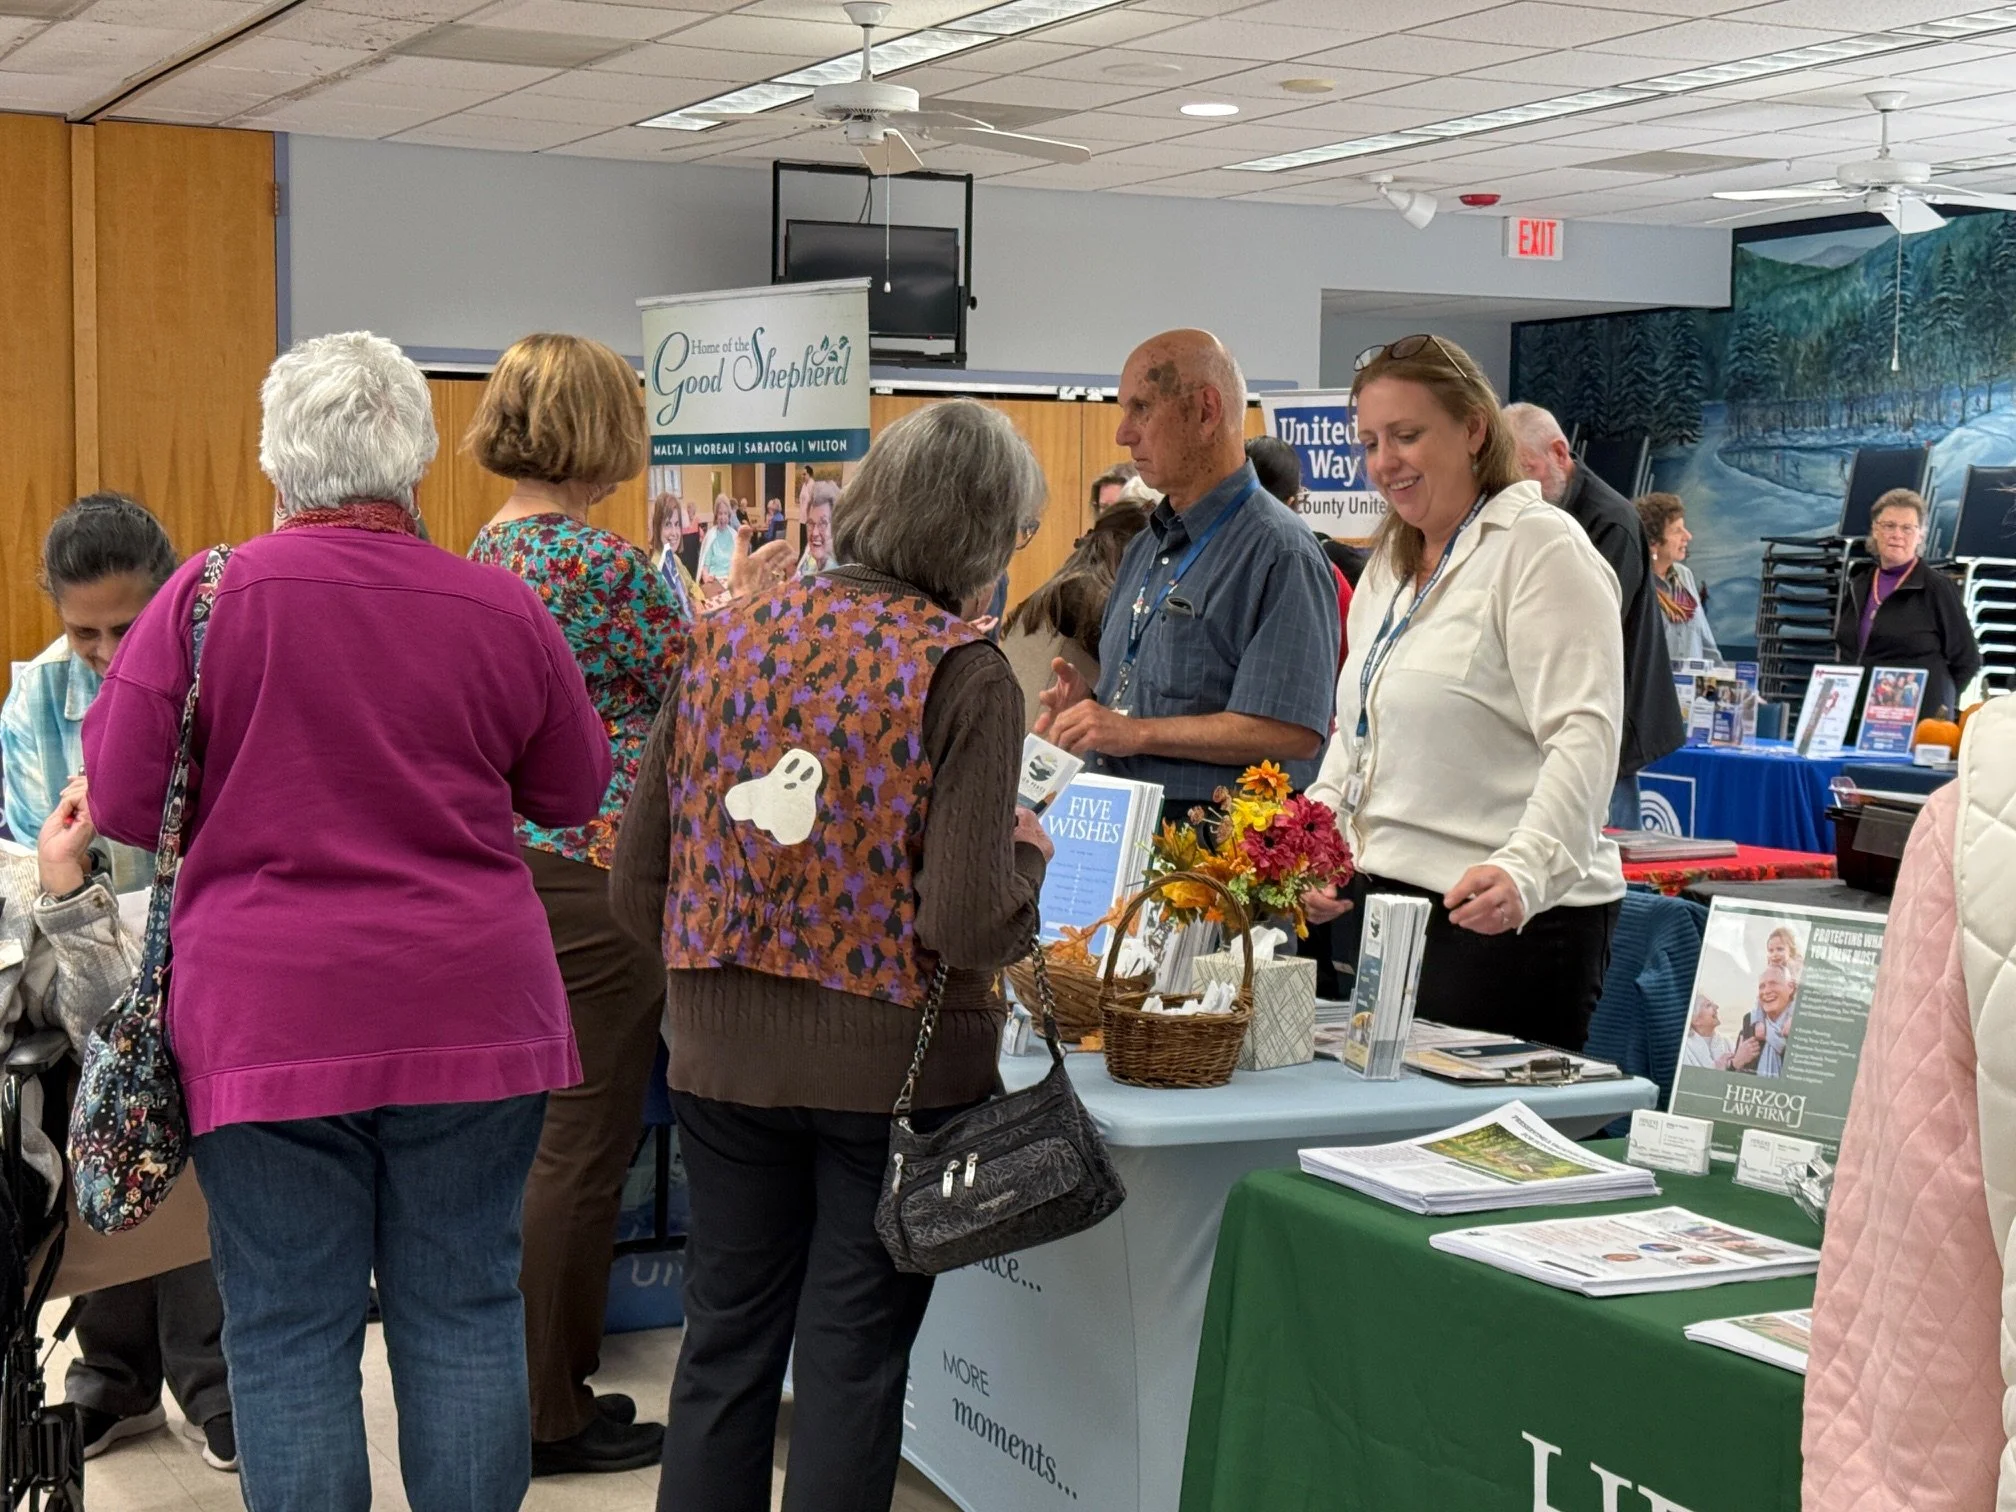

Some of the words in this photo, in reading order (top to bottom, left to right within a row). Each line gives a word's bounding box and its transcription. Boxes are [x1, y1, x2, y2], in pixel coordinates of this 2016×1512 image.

[1519, 220, 1557, 256] EXIT
[691, 339, 720, 355] Home
[722, 338, 734, 353] of
[735, 337, 749, 352] the
[652, 331, 725, 426] Good
[733, 326, 851, 417] Shepherd
[1279, 414, 1361, 446] United
[654, 443, 684, 457] MALTA
[694, 442, 735, 455] MOREAU
[745, 441, 798, 454] SARATOGA
[808, 439, 847, 452] WILTON
[1308, 449, 1361, 487] Way
[1068, 796, 1113, 821] FIVE
[1048, 815, 1122, 845] WISHES
[1813, 927, 1863, 947] PROTECTING
[1722, 1101, 1754, 1118] LAW
[1755, 1105, 1792, 1124] FIRM
[942, 1350, 990, 1397] MORE
[952, 1397, 1078, 1500] moments...
